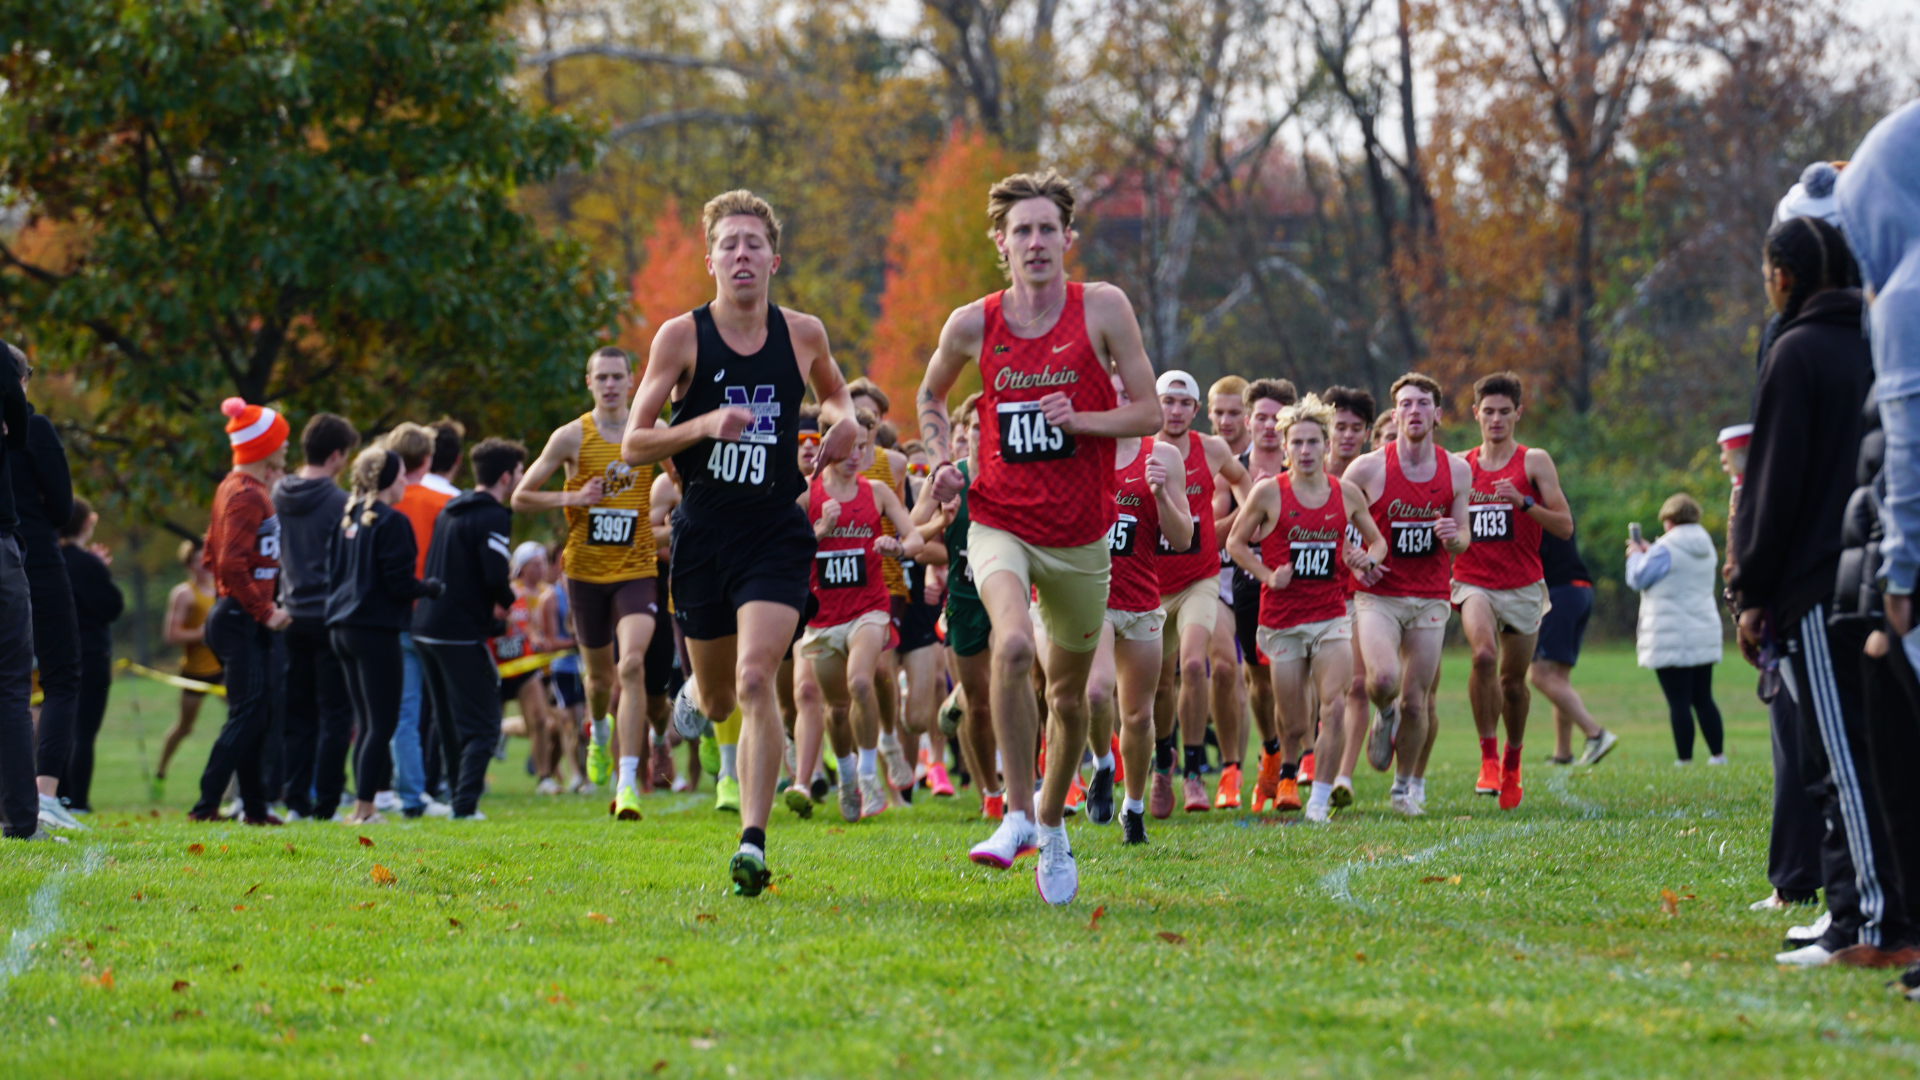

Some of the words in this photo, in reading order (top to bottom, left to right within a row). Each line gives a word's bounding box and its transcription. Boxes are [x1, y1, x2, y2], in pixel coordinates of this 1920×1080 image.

[994, 364, 1079, 391] Otterbein
[707, 441, 767, 485] 4079
[592, 515, 633, 542] 3997
[1107, 521, 1128, 550] 45
[1287, 524, 1339, 541] Otterbein
[1473, 511, 1507, 537] 4133
[1397, 528, 1432, 553] 4134
[824, 555, 859, 584] 4141
[1295, 549, 1329, 575] 4142
